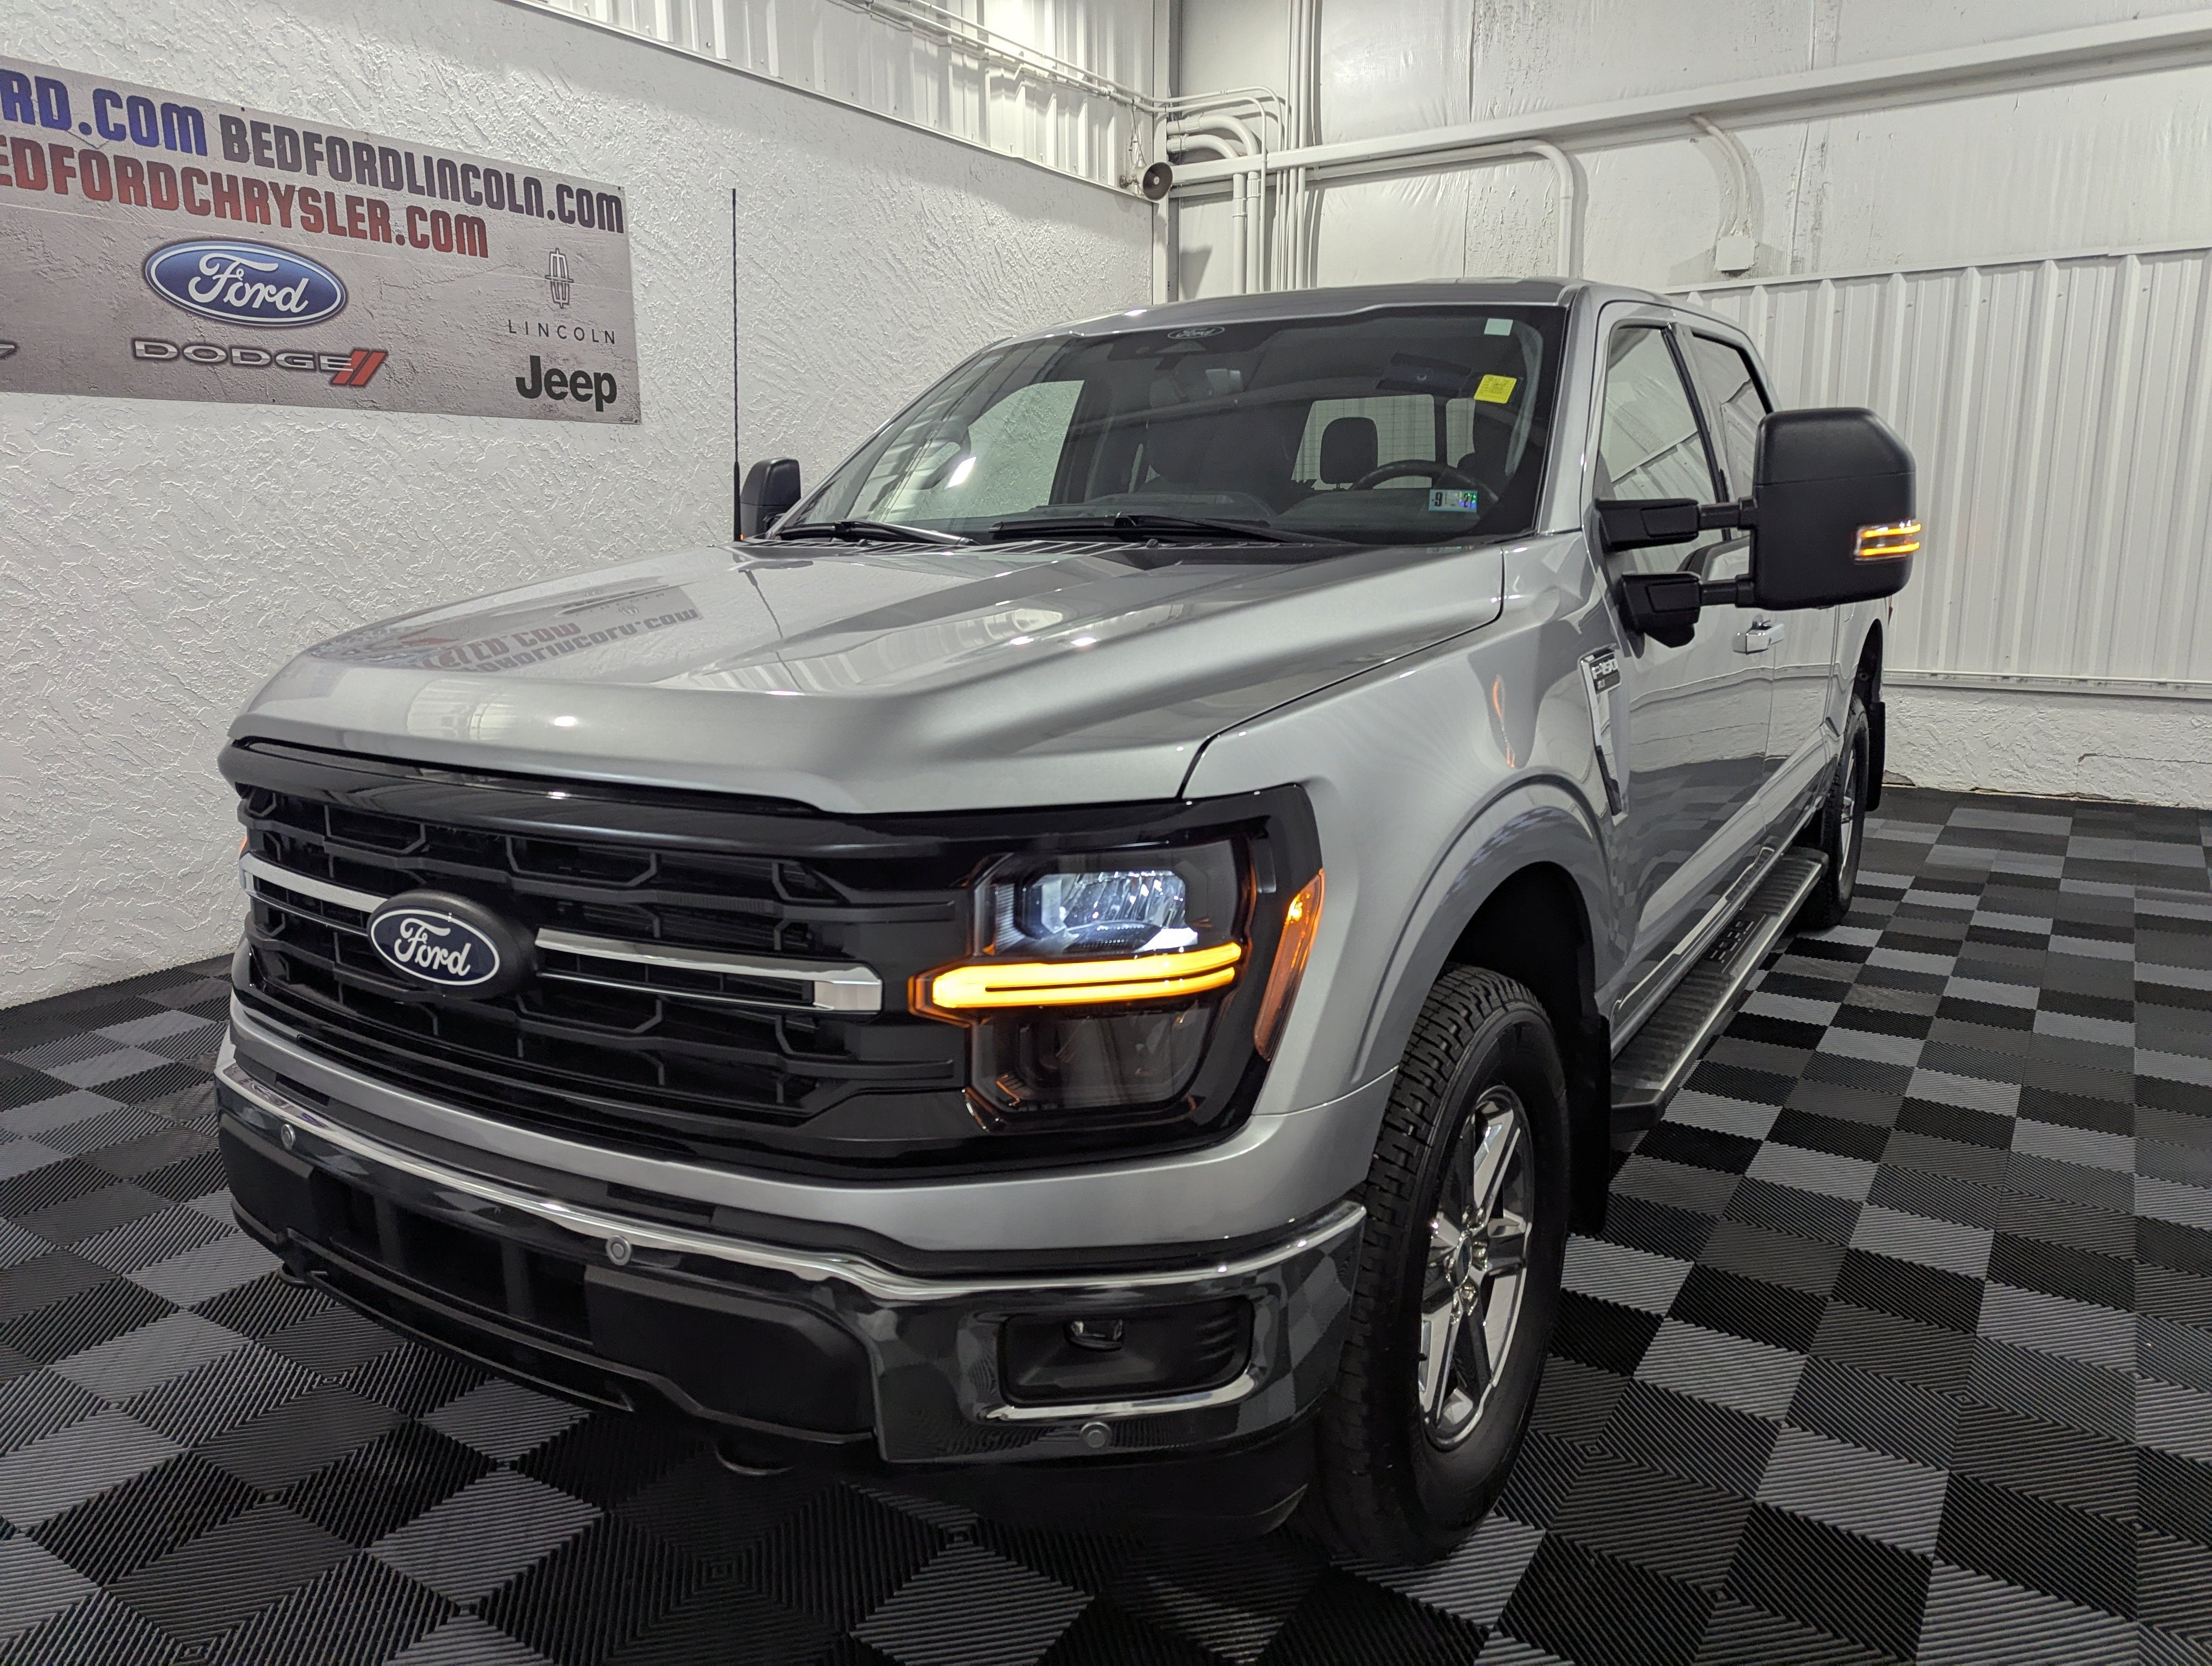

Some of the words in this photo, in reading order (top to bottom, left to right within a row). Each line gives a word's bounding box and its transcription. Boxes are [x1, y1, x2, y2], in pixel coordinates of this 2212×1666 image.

[0, 69, 208, 156] RD.COM
[219, 114, 624, 234] BEDFORDLINCOLN.COM
[188, 253, 309, 313] Ford
[134, 340, 353, 373] DODGE
[509, 319, 615, 344] LINCOLN
[516, 355, 618, 412] Jeep
[394, 917, 472, 976] Ford
